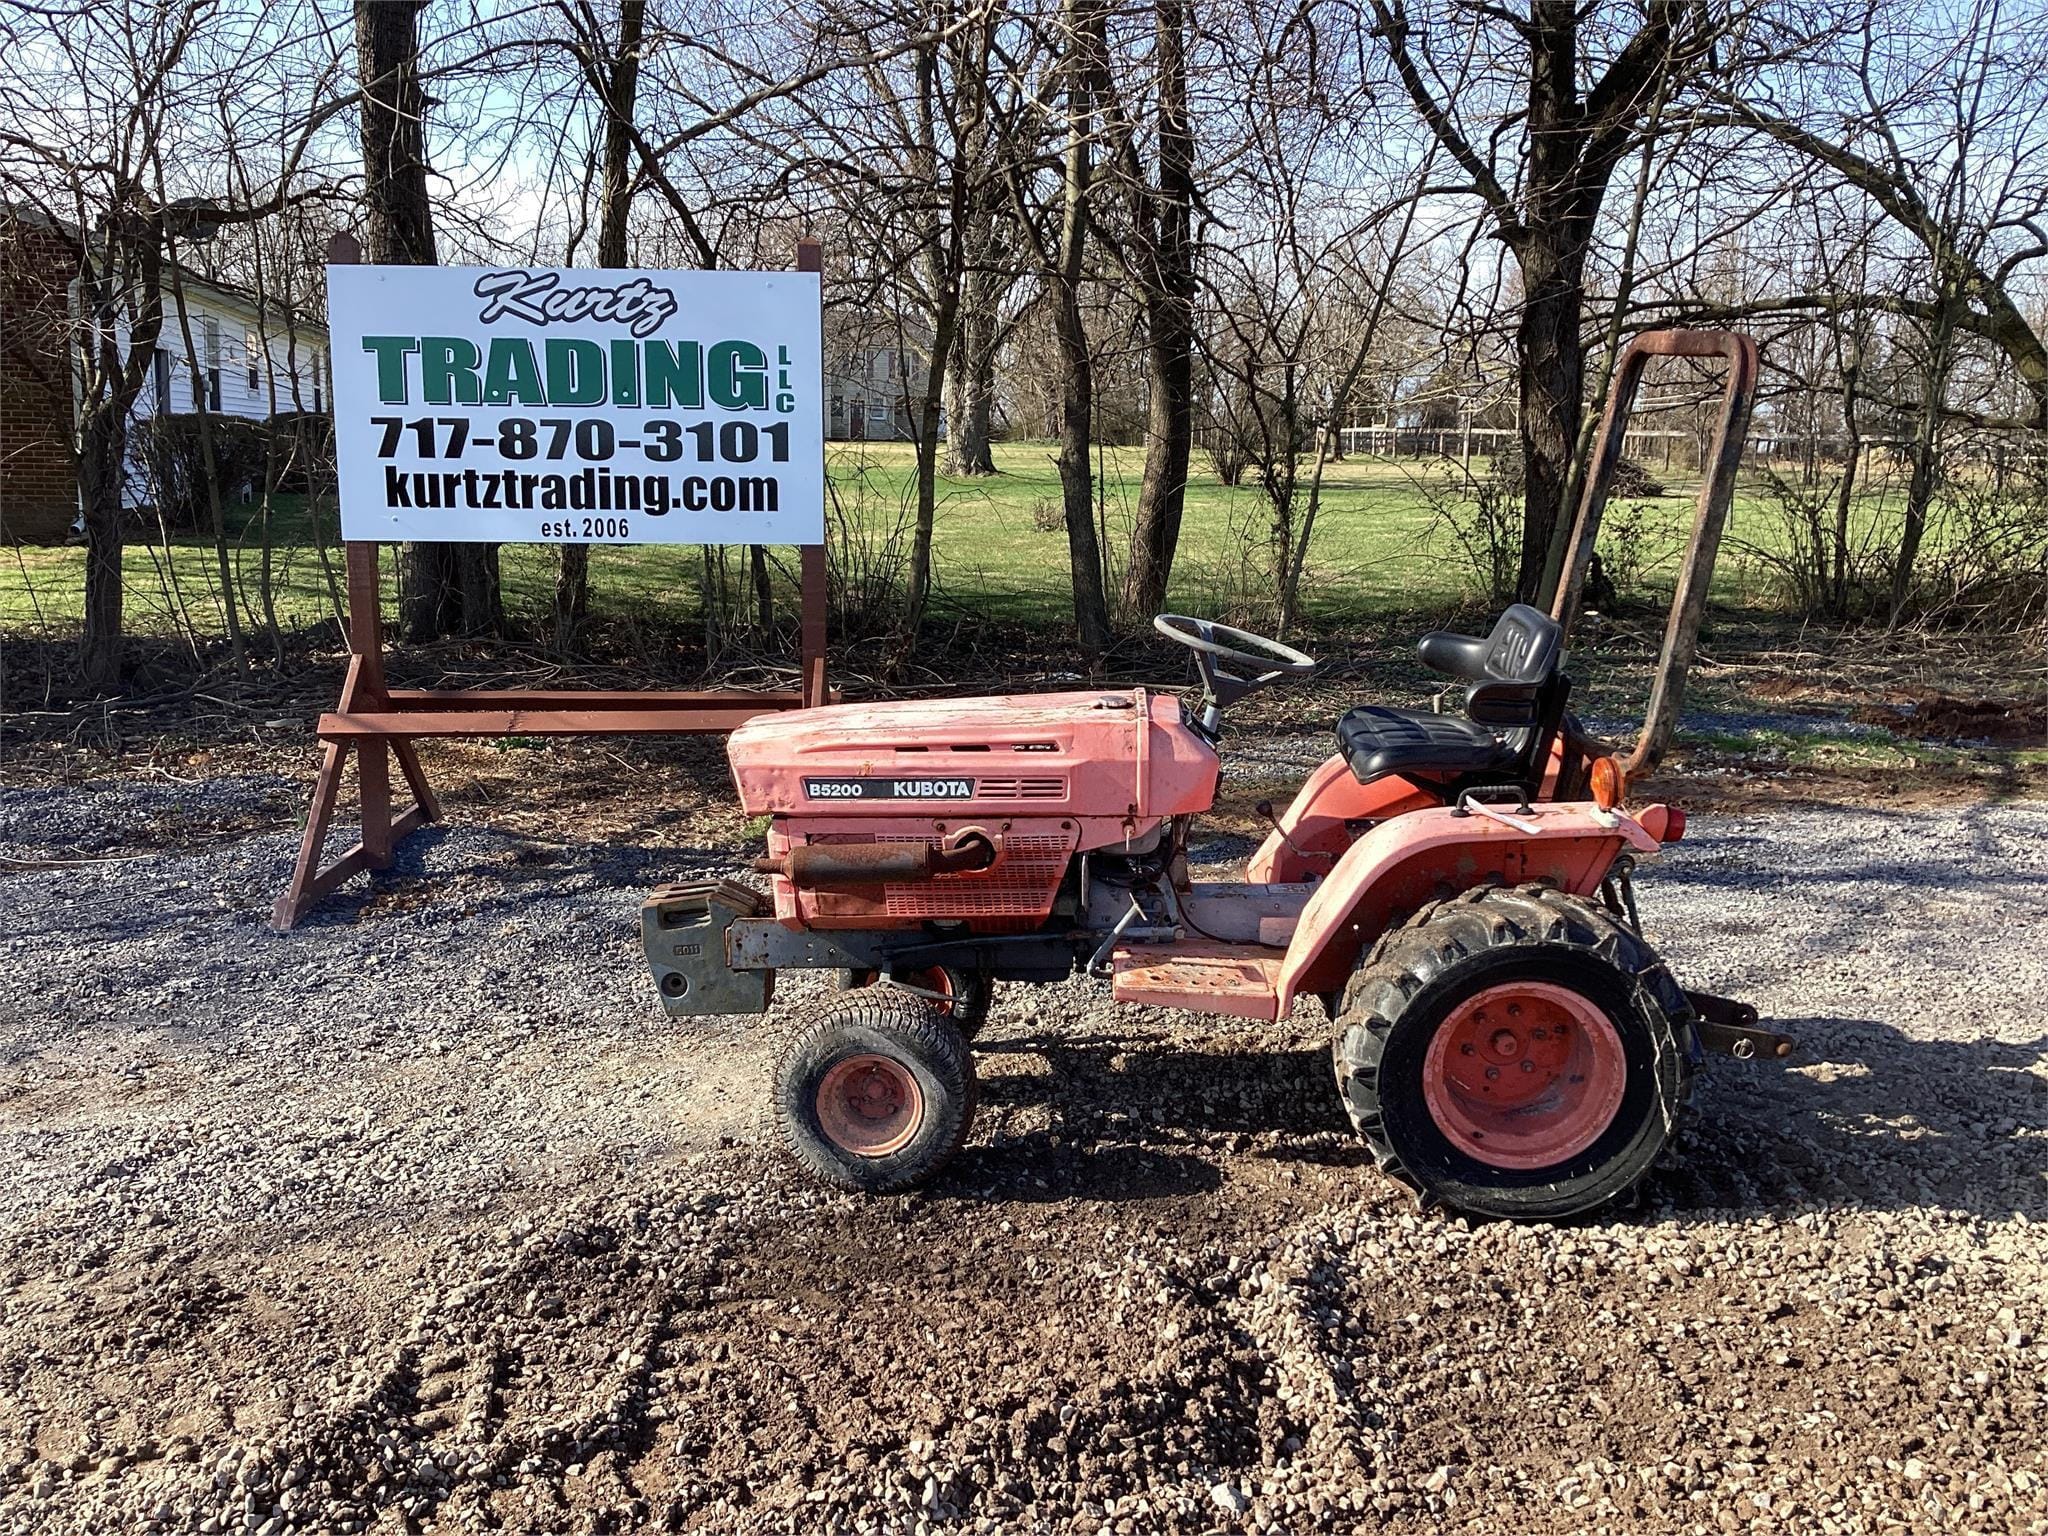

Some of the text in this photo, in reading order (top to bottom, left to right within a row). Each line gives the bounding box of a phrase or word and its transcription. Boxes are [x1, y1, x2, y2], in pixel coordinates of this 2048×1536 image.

[474, 270, 678, 338] Kurtz
[362, 336, 769, 410] TRADING
[776, 345, 795, 413] LLC
[371, 417, 790, 462] 717-870-3101
[384, 465, 779, 516] kurtztrading.com
[541, 519, 630, 539] est. 2006
[809, 780, 971, 797] B5200 KUBOTA
